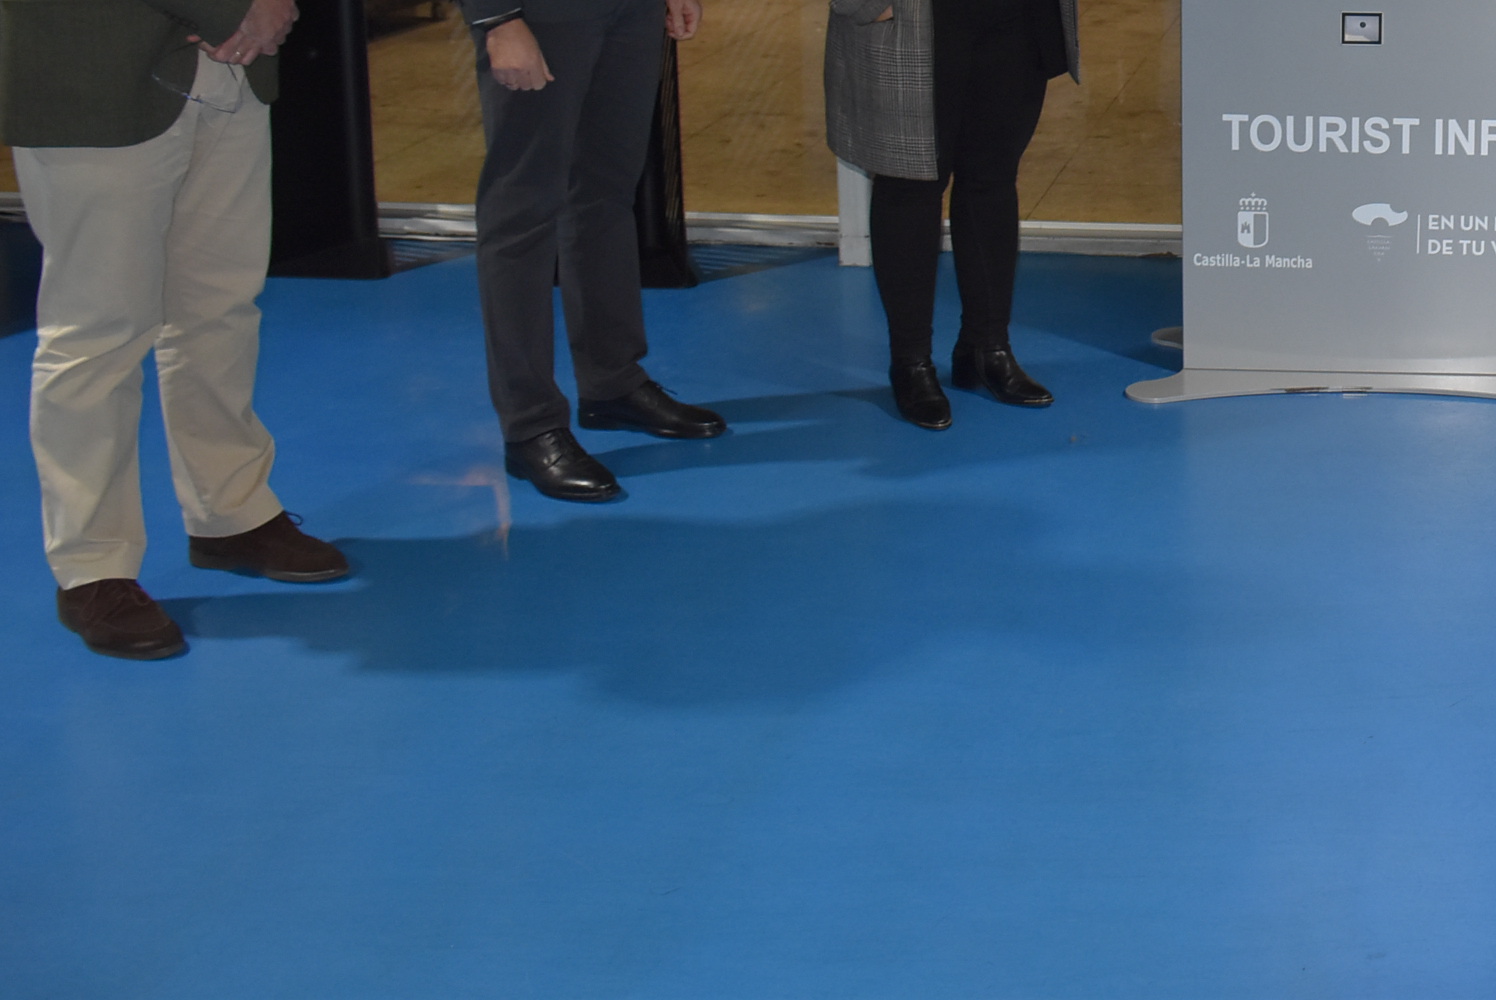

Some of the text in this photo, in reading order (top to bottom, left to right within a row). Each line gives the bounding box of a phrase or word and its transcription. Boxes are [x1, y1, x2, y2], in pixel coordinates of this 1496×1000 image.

[1221, 113, 1421, 155] TOURIST
[1428, 214, 1454, 230] EN
[1460, 215, 1490, 232] UN
[1427, 239, 1454, 256] DE
[1459, 240, 1486, 256] TU
[1193, 253, 1314, 269] Castilla-La Mancha
